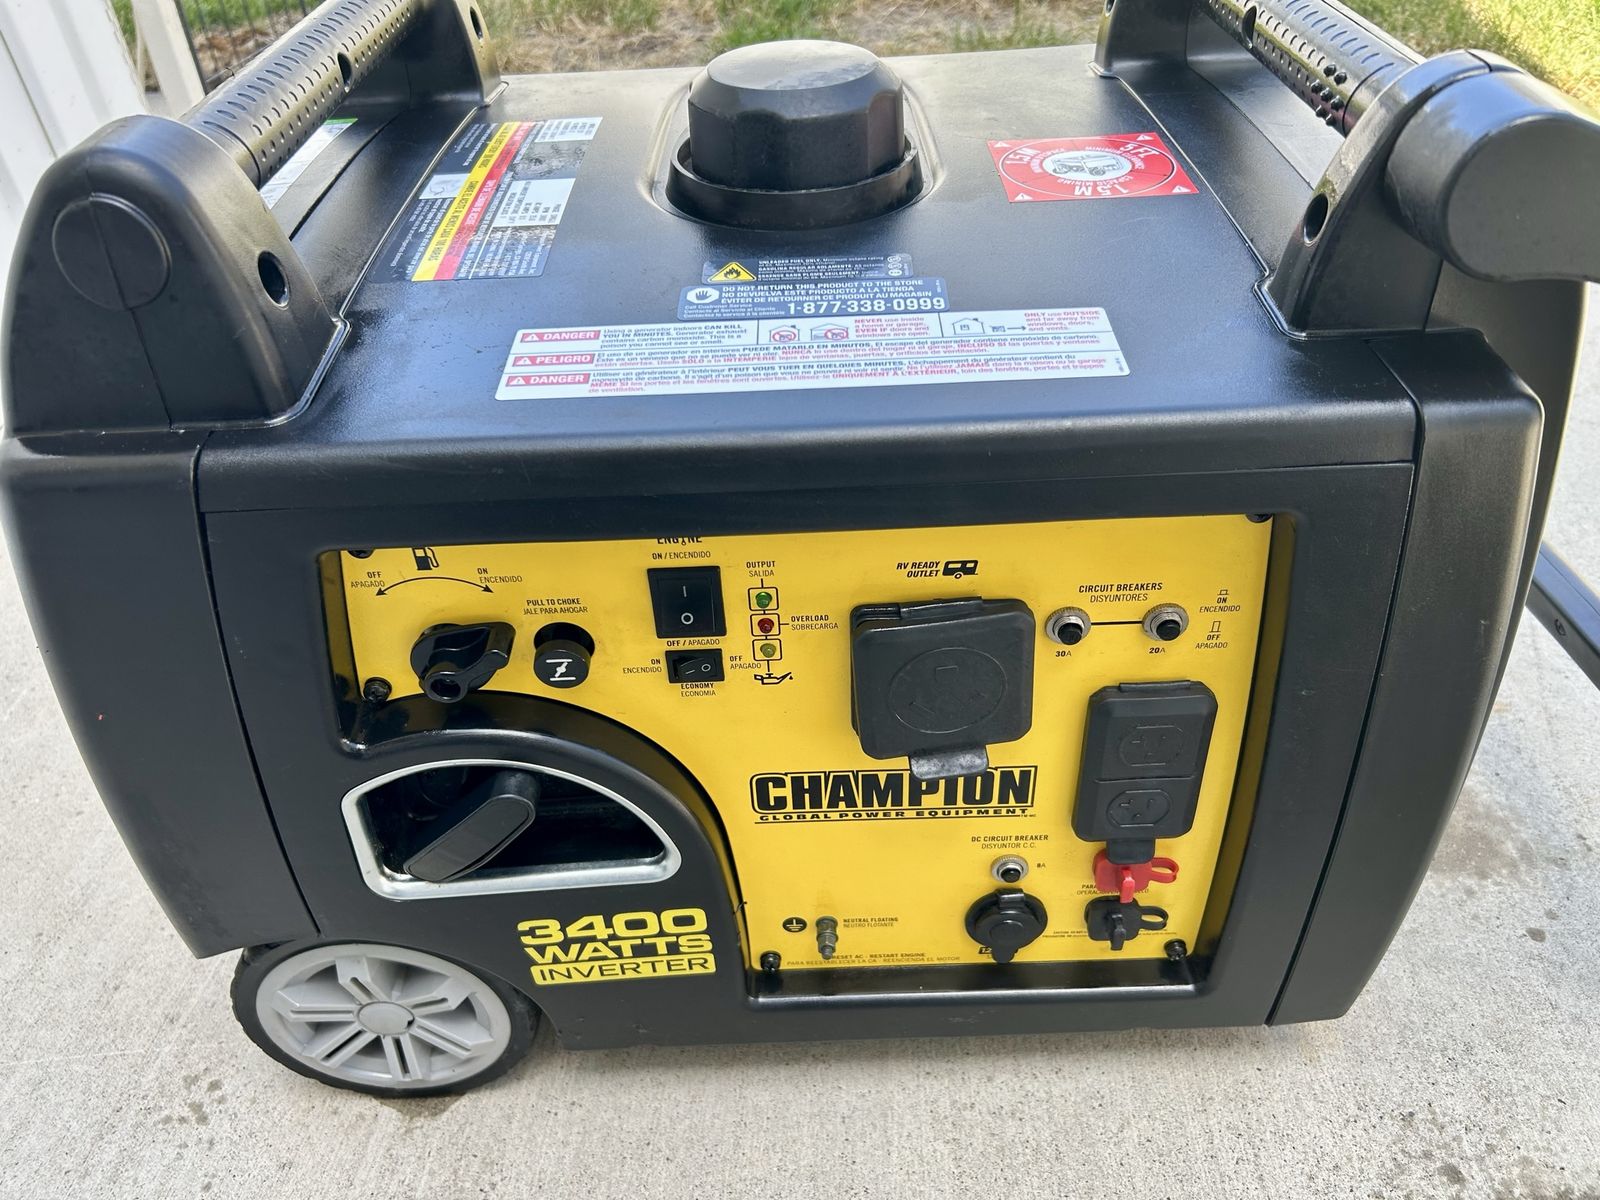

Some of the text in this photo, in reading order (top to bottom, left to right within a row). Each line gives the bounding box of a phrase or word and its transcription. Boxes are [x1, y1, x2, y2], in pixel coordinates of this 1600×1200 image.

[787, 297, 946, 315] 1-877-338-0999
[544, 331, 595, 341] DANGER
[634, 331, 673, 339] MINUTES.
[773, 344, 815, 352] MATARLO
[536, 355, 591, 365] PELIGRO
[816, 361, 862, 369] QUELQUES
[530, 375, 585, 385] DANGER
[652, 552, 663, 560] ON
[669, 551, 711, 560] ENCENDIDO
[746, 561, 776, 569] OUTPUT
[896, 561, 940, 570] RV READY
[367, 571, 382, 579] OFF
[477, 567, 489, 575] ON
[906, 570, 940, 578] OUTLET
[350, 580, 386, 588] APAGADO
[479, 576, 523, 584] ENCENDIDO
[1079, 583, 1163, 593] CIRCUIT BREAKERS
[1090, 593, 1148, 603] DISYUNTORES
[526, 599, 545, 607] PULL
[523, 606, 589, 616] JALE PARA AHOGAR
[1199, 605, 1241, 613] ENCENDIDO
[790, 614, 830, 622] OVERLOAD
[791, 623, 839, 631] SOBRECARGA
[688, 638, 720, 646] APAGADO
[1195, 642, 1229, 650] APAGADO
[622, 666, 662, 674] ENCENDIDO
[729, 662, 762, 670] APAGADO
[680, 682, 714, 690] ECONOMY
[680, 690, 717, 698] ECONOMIA
[755, 768, 1032, 811] CHAMPION
[759, 813, 831, 822] GLOBAL
[838, 811, 905, 819] POWER
[915, 808, 1028, 817] EQUIPMENT
[517, 908, 708, 945] 3400
[524, 934, 714, 964] WATTS
[540, 957, 710, 981] INVERTER
